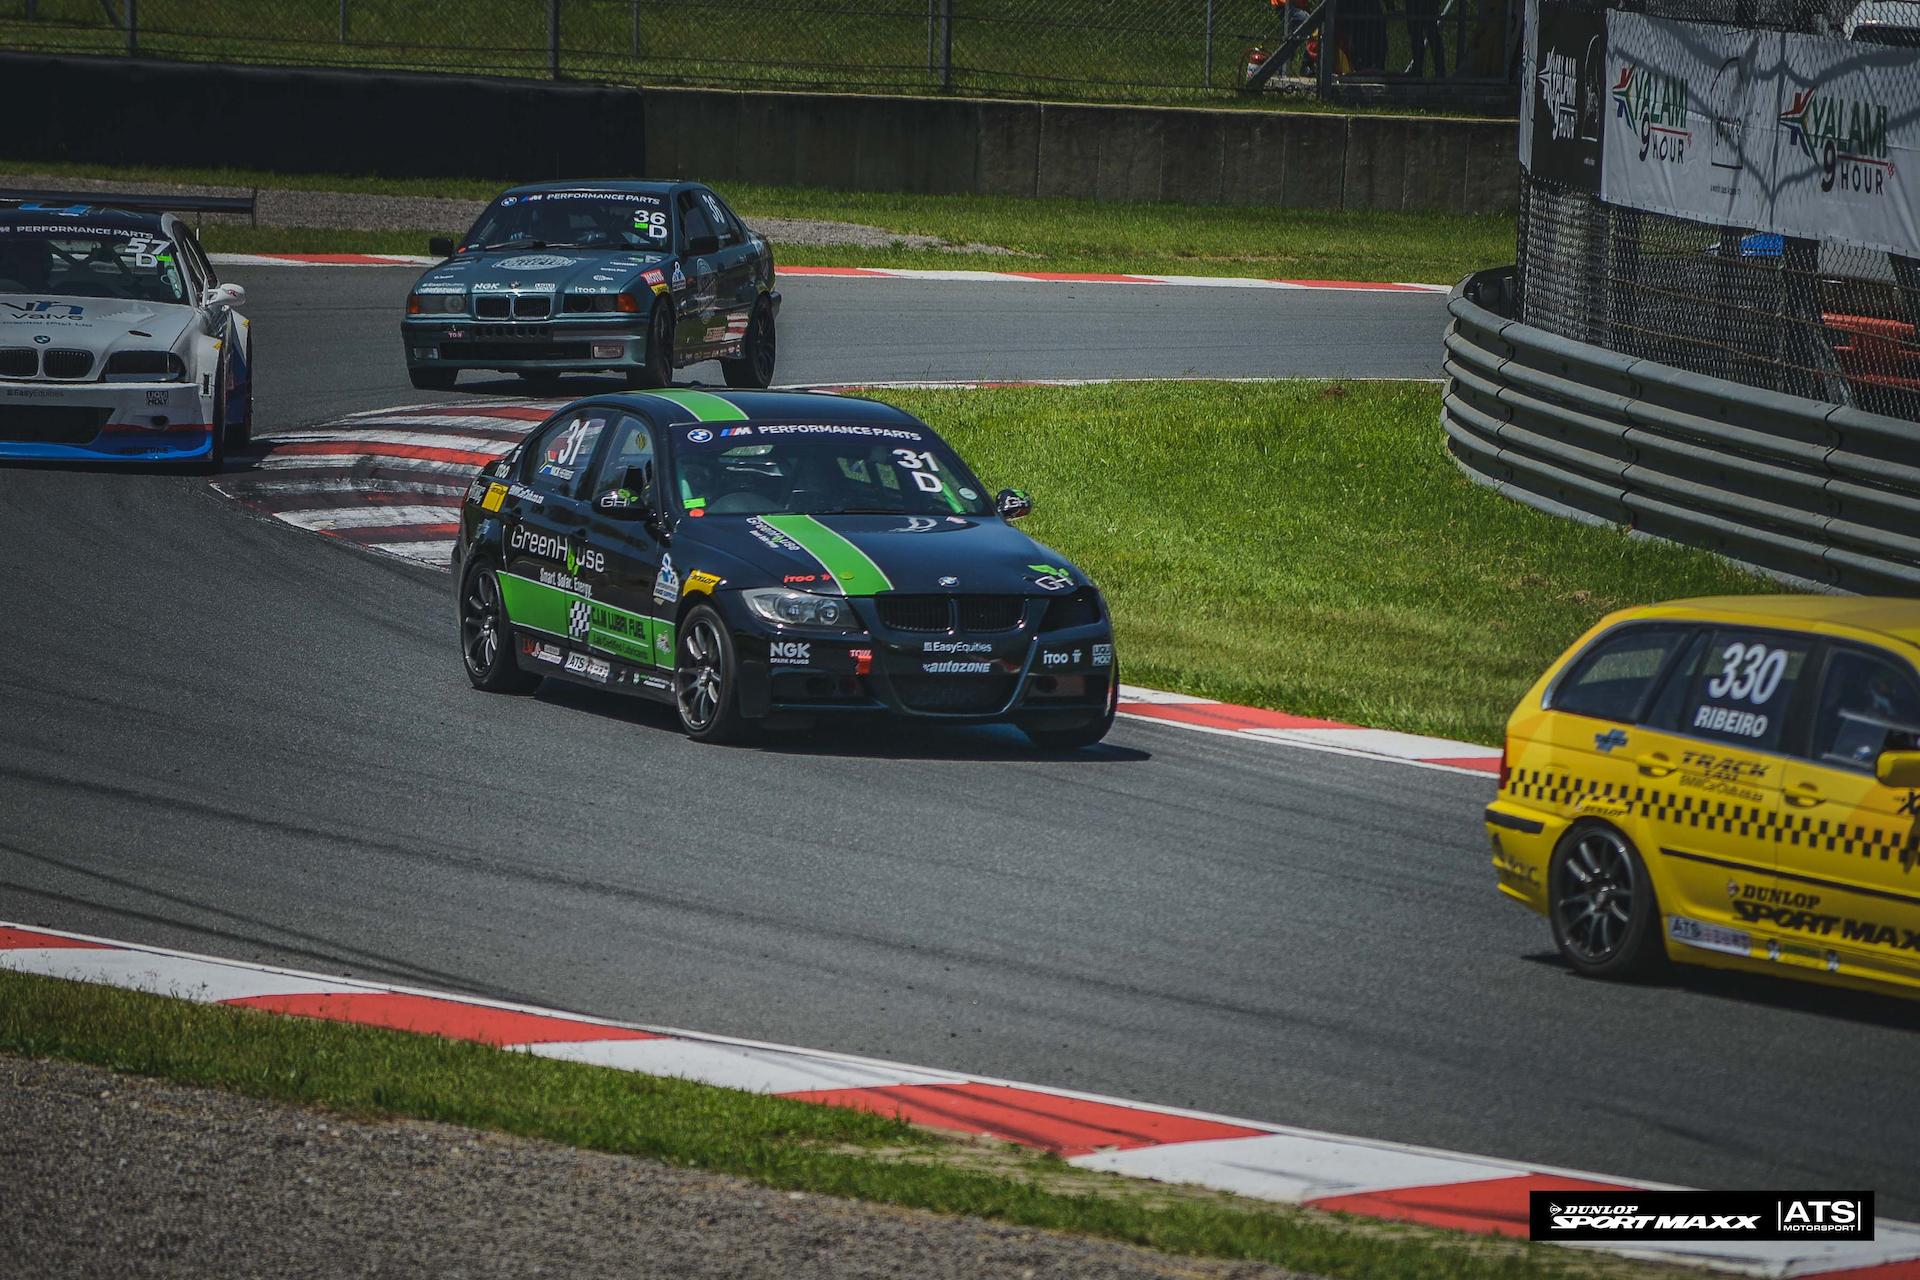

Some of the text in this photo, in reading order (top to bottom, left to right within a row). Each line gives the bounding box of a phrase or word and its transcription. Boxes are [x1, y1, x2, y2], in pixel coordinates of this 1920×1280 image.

[1639, 112, 1684, 164] 9 HOUR
[1821, 140, 1884, 195] 9 HOUR
[547, 192, 625, 202] PERFORMANCE
[626, 195, 660, 205] PARTS
[633, 210, 667, 225] 36
[17, 225, 111, 235] PERFORMANCE
[114, 230, 154, 240] PARTS
[648, 225, 668, 239] D
[125, 237, 171, 255] 57
[136, 253, 158, 268] D
[473, 282, 501, 290] NGK
[558, 418, 592, 465] 31
[758, 425, 874, 437] PERFORMANCE
[874, 429, 922, 441] PARTS
[892, 448, 940, 472] 31
[911, 470, 943, 493] D
[770, 642, 810, 658] NGK
[933, 641, 992, 653] EasyEquities
[1709, 642, 1787, 704] 330
[1694, 705, 1768, 737] RIBEIRO
[1682, 750, 1770, 778] TRACK
[1743, 883, 1821, 910] DUNLOP
[1732, 899, 1841, 936] SPORT
